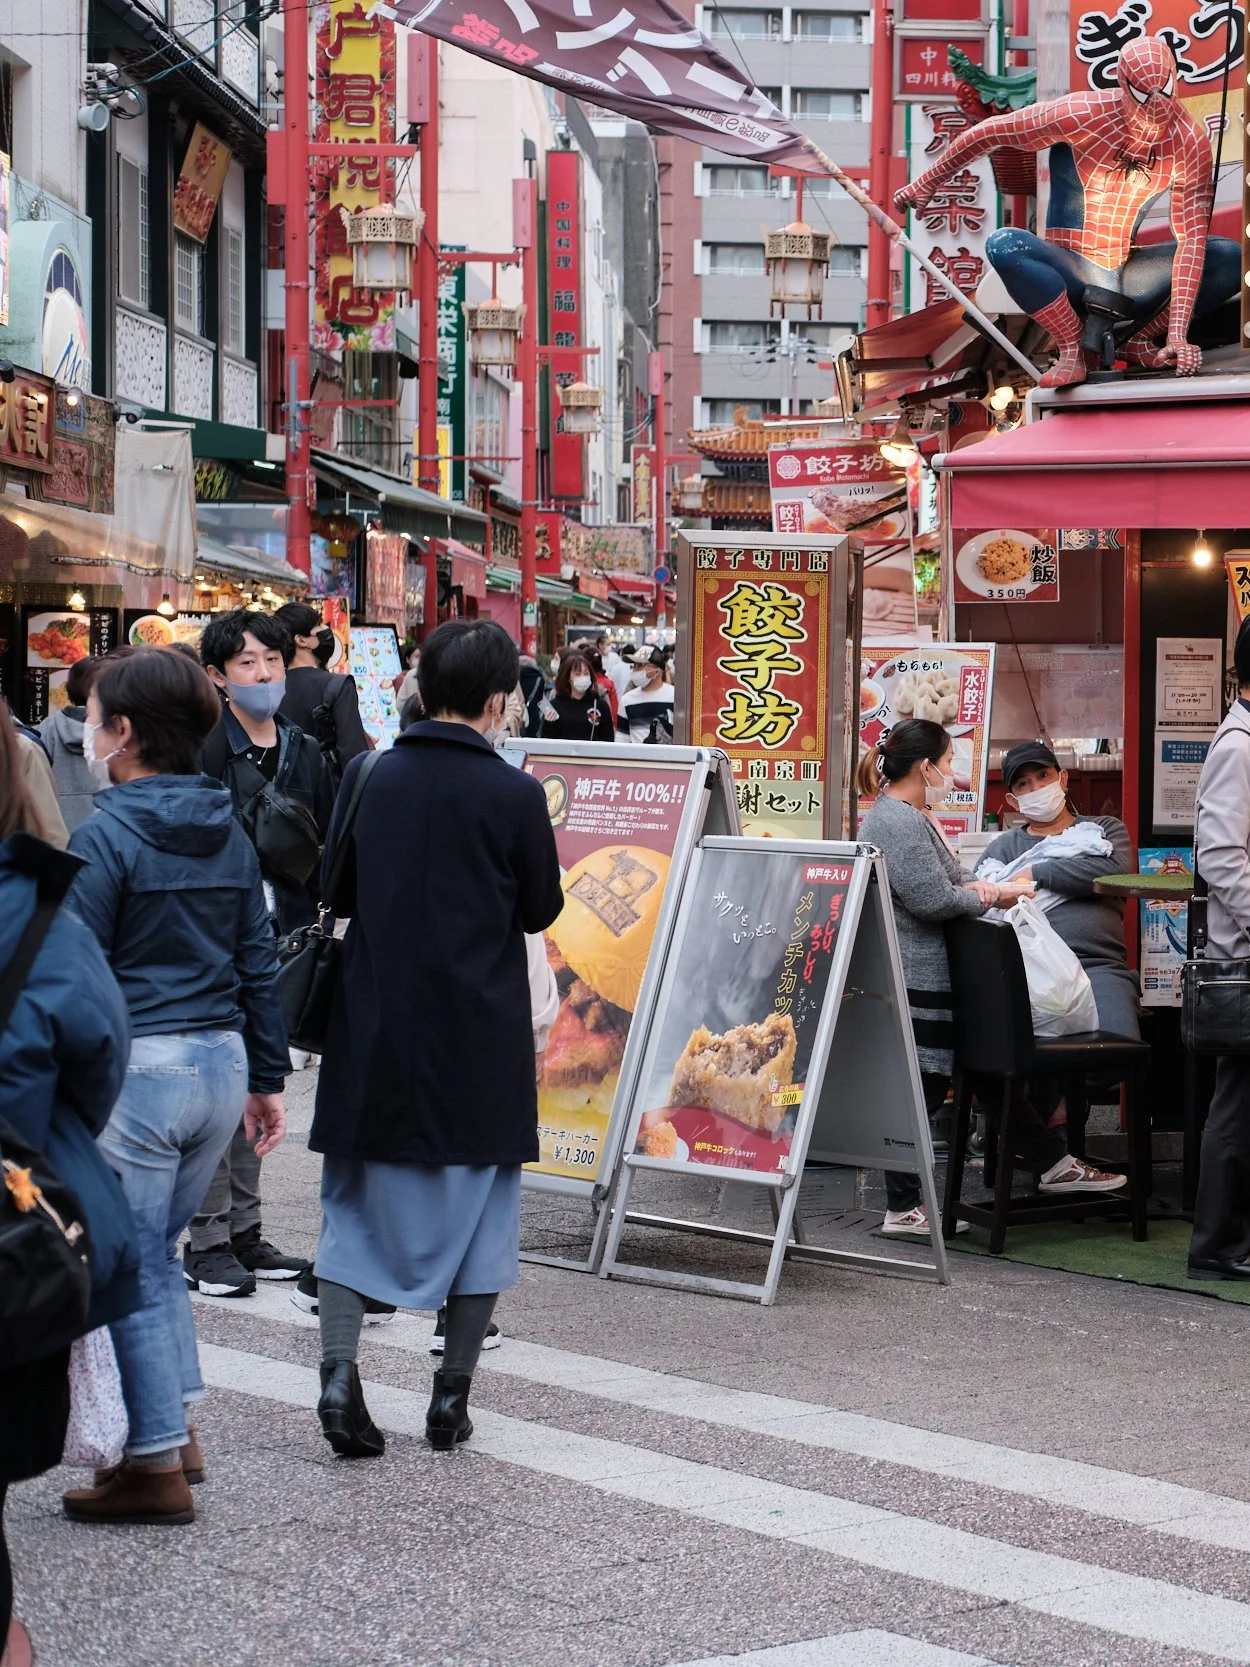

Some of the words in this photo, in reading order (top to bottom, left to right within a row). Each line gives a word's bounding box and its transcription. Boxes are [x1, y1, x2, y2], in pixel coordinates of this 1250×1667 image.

[906, 72, 962, 88] 四川料
[696, 548, 829, 572] 餃子専門店
[1031, 544, 1056, 583] 炒飯
[717, 581, 809, 750] 餃子坊
[963, 671, 980, 721] 水餃子
[573, 777, 622, 802] 神戸牛
[625, 782, 686, 804] 100%!!
[806, 867, 849, 882] 神戸牛入り
[774, 891, 815, 1021] メンチカツ
[553, 1145, 596, 1165] ¥1,300
